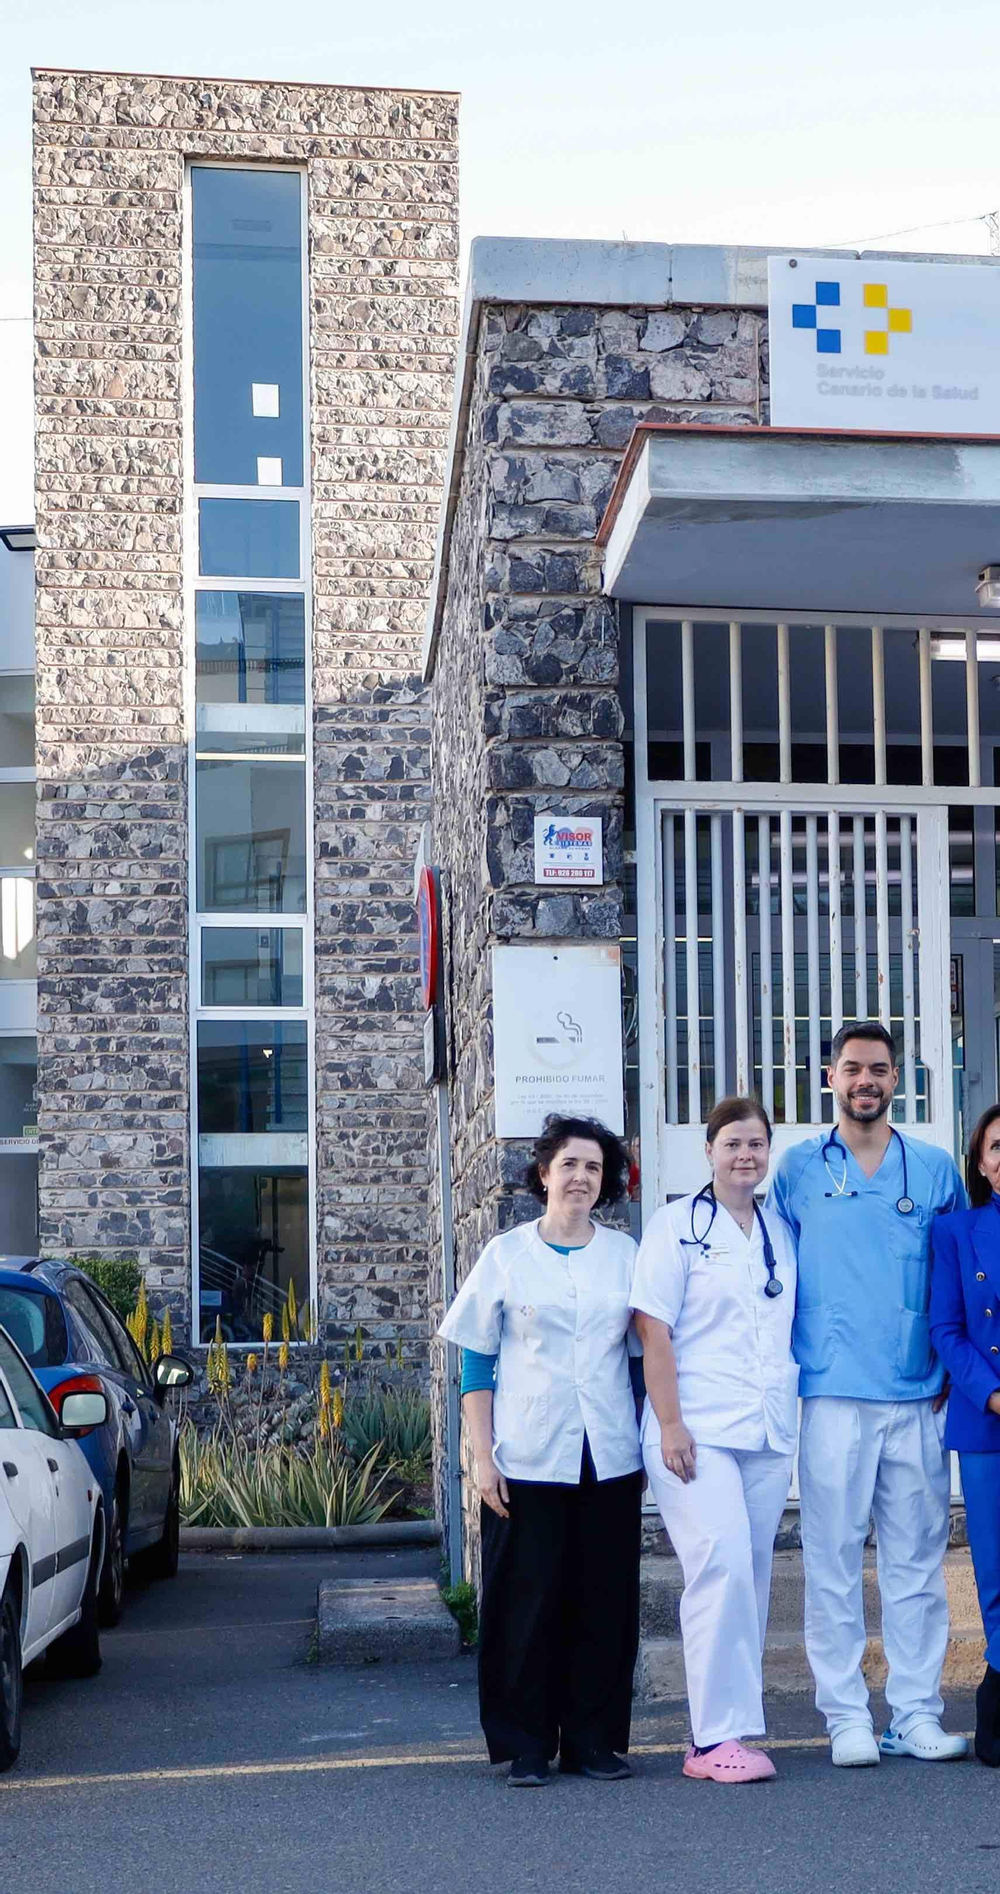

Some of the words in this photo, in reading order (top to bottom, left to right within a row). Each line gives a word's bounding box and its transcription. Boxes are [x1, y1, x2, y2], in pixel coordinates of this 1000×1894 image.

[816, 363, 885, 380] Servicio
[816, 381, 883, 397] Canario
[931, 385, 979, 400] Salud
[556, 832, 592, 841] VISOR
[515, 1075, 570, 1084] PROHIBIDO
[571, 1074, 605, 1083] FUMAR
